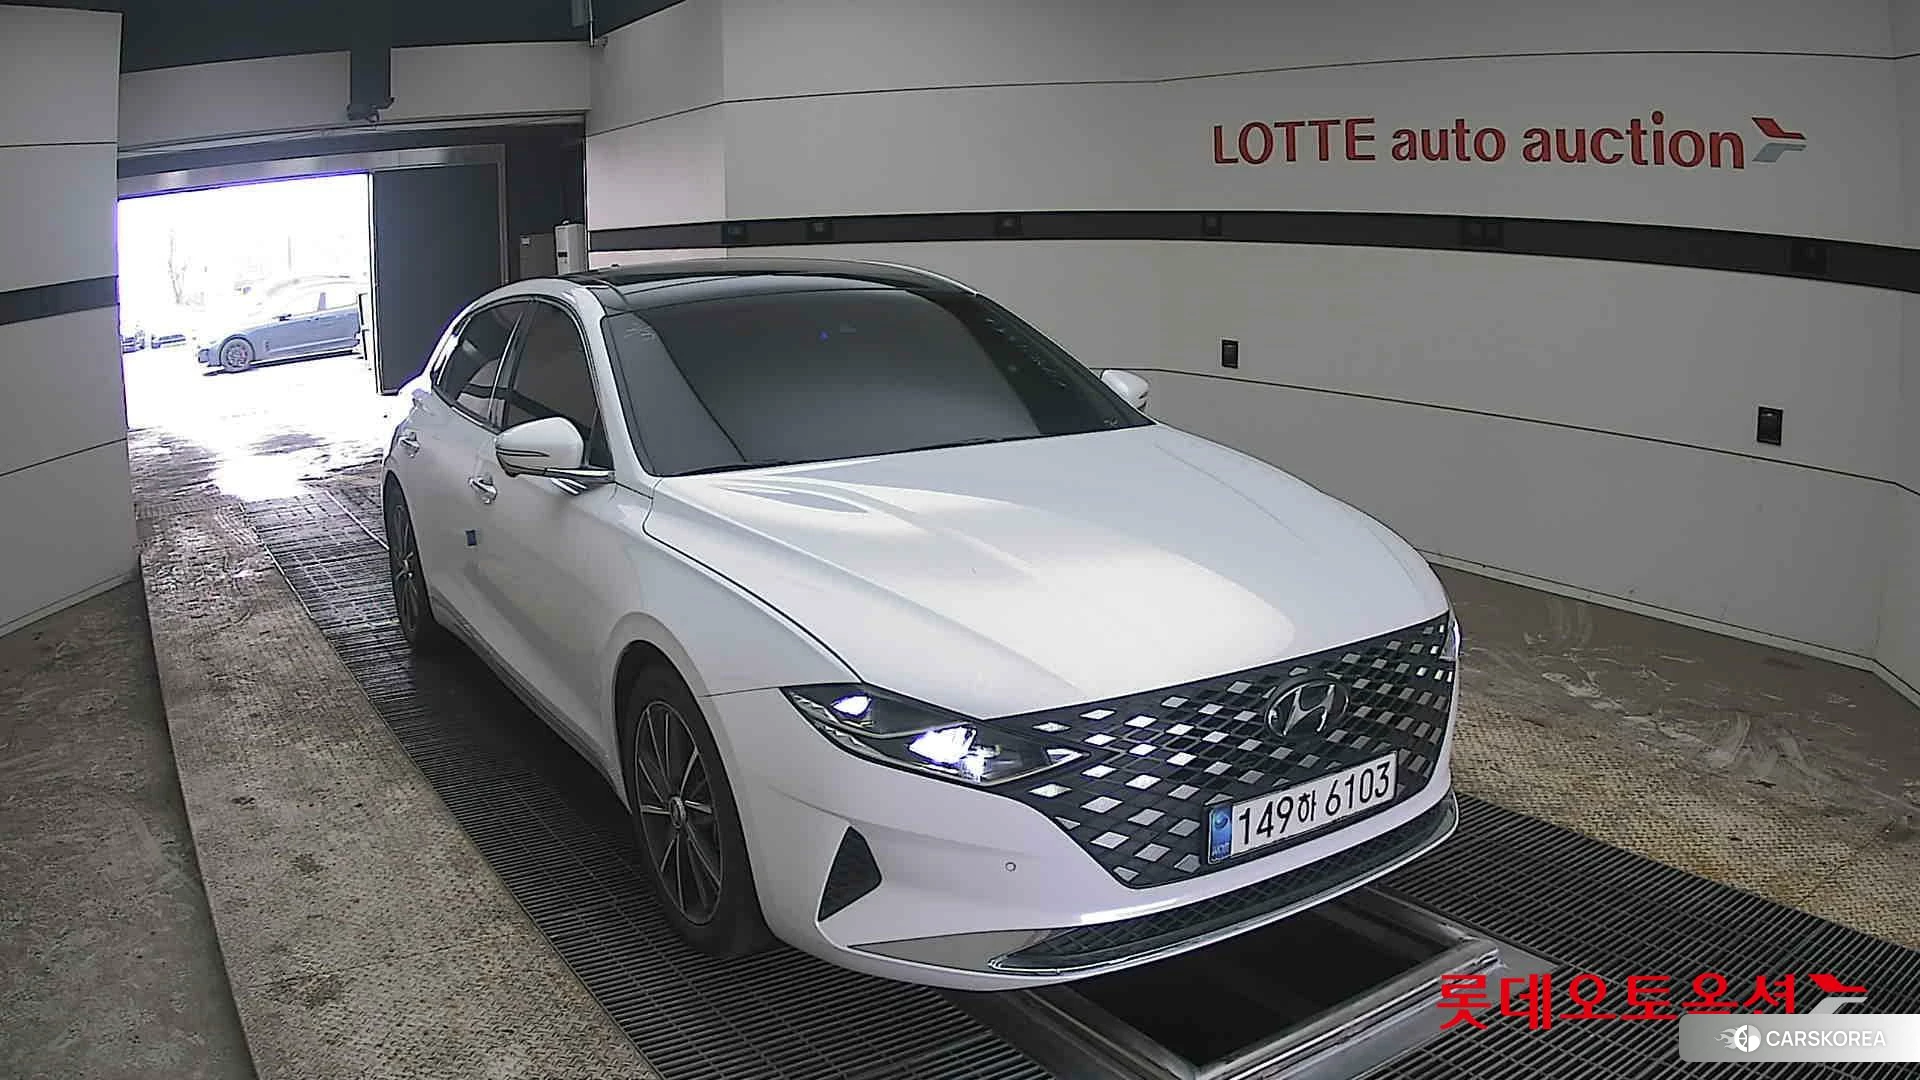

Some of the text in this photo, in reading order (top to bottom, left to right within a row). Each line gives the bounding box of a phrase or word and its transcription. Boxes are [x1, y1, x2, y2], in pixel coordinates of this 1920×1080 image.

[1213, 111, 1745, 170] LOTTE auto auction
[1239, 761, 1391, 845] 149하 6103
